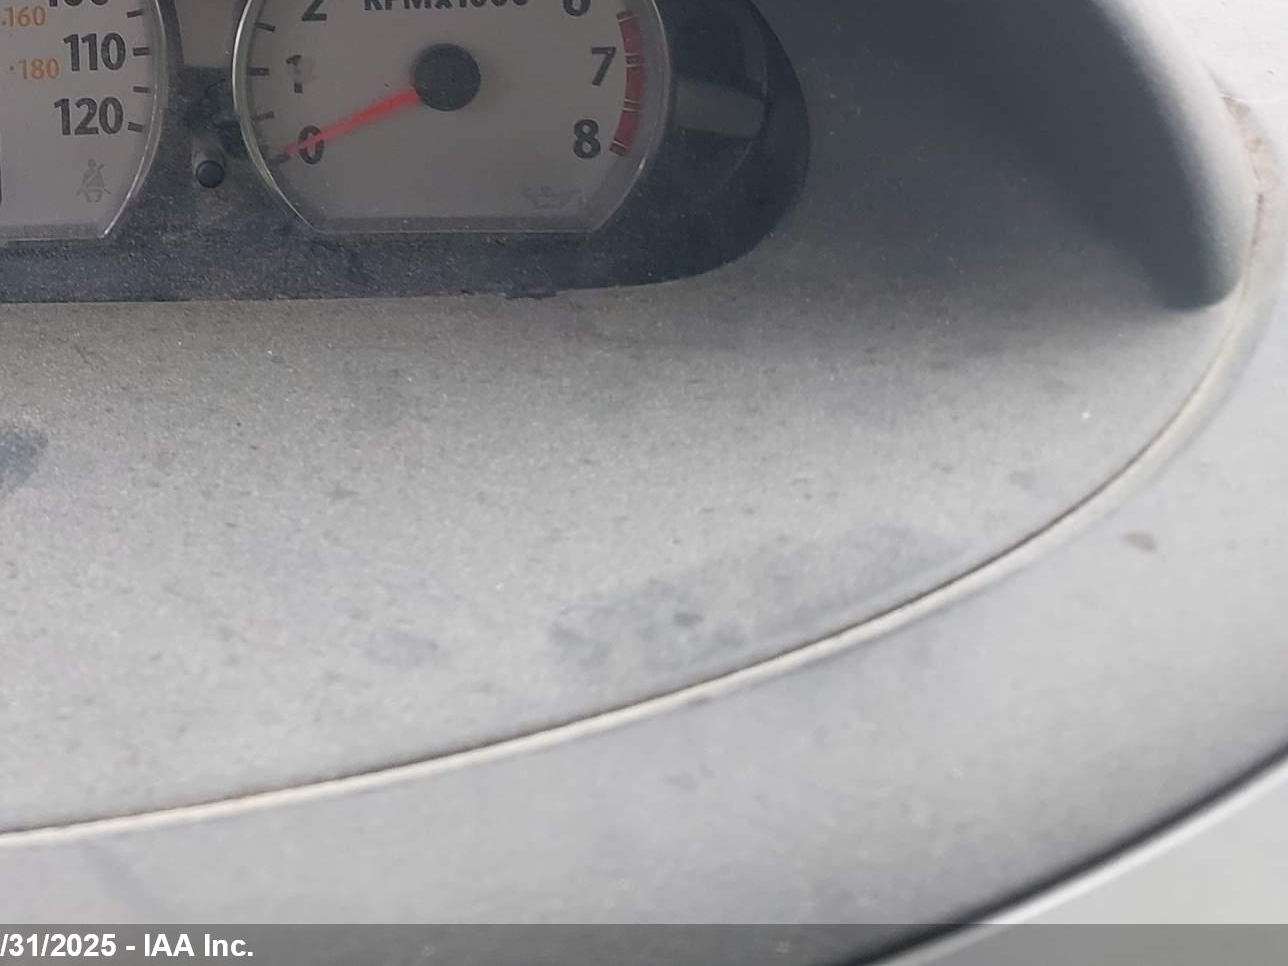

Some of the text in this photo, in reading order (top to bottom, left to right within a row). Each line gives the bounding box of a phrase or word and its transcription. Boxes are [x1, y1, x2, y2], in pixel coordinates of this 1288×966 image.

[6, 6, 46, 27] 160
[18, 58, 60, 80] 180
[63, 33, 126, 71] 110
[591, 46, 616, 86] 7
[54, 96, 124, 136] 120
[298, 125, 325, 165] 0
[573, 119, 601, 159] 8
